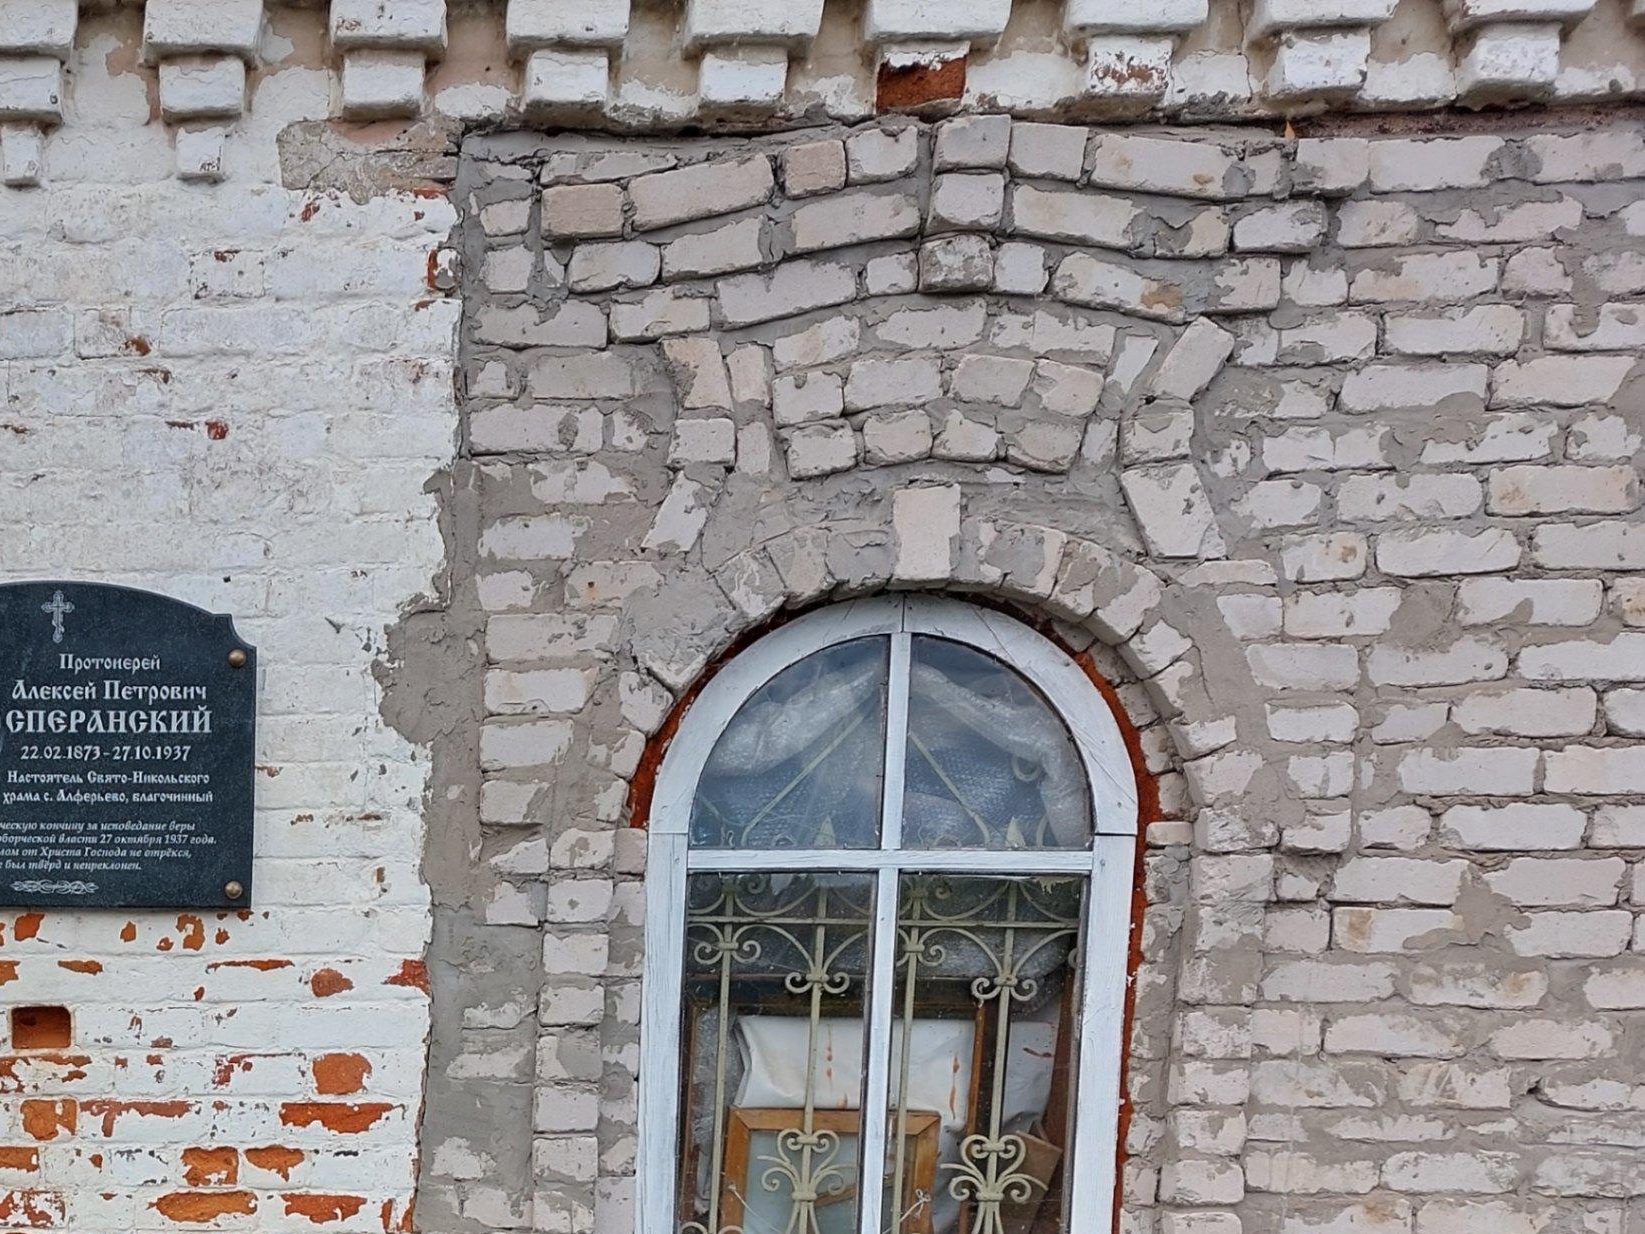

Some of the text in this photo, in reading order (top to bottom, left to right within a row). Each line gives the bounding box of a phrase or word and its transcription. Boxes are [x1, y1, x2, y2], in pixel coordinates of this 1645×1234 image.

[59, 653, 161, 674] Протоиерей
[11, 679, 207, 705] Алексей Петрович
[5, 704, 213, 734] СПЕРАНСКИЙ
[20, 745, 101, 761] 22.02.1873
[112, 745, 192, 761] 27.10.1937
[7, 770, 210, 784] Настоятель Свято-Никольского
[2, 789, 213, 804] храма с. Алферьево, благочинный
[39, 822, 84, 833] кончину
[86, 822, 98, 831] за
[100, 820, 167, 831] исповедание
[169, 821, 196, 833] веры
[58, 834, 97, 844] власти
[99, 834, 113, 844] 27
[114, 834, 162, 847] октября
[164, 834, 189, 845] 1937
[190, 835, 217, 845] года.
[21, 849, 37, 857] от
[39, 846, 81, 859] Христа
[83, 847, 127, 857] Господа
[129, 849, 141, 857] не
[5, 859, 26, 869] был
[64, 862, 71, 870] и
